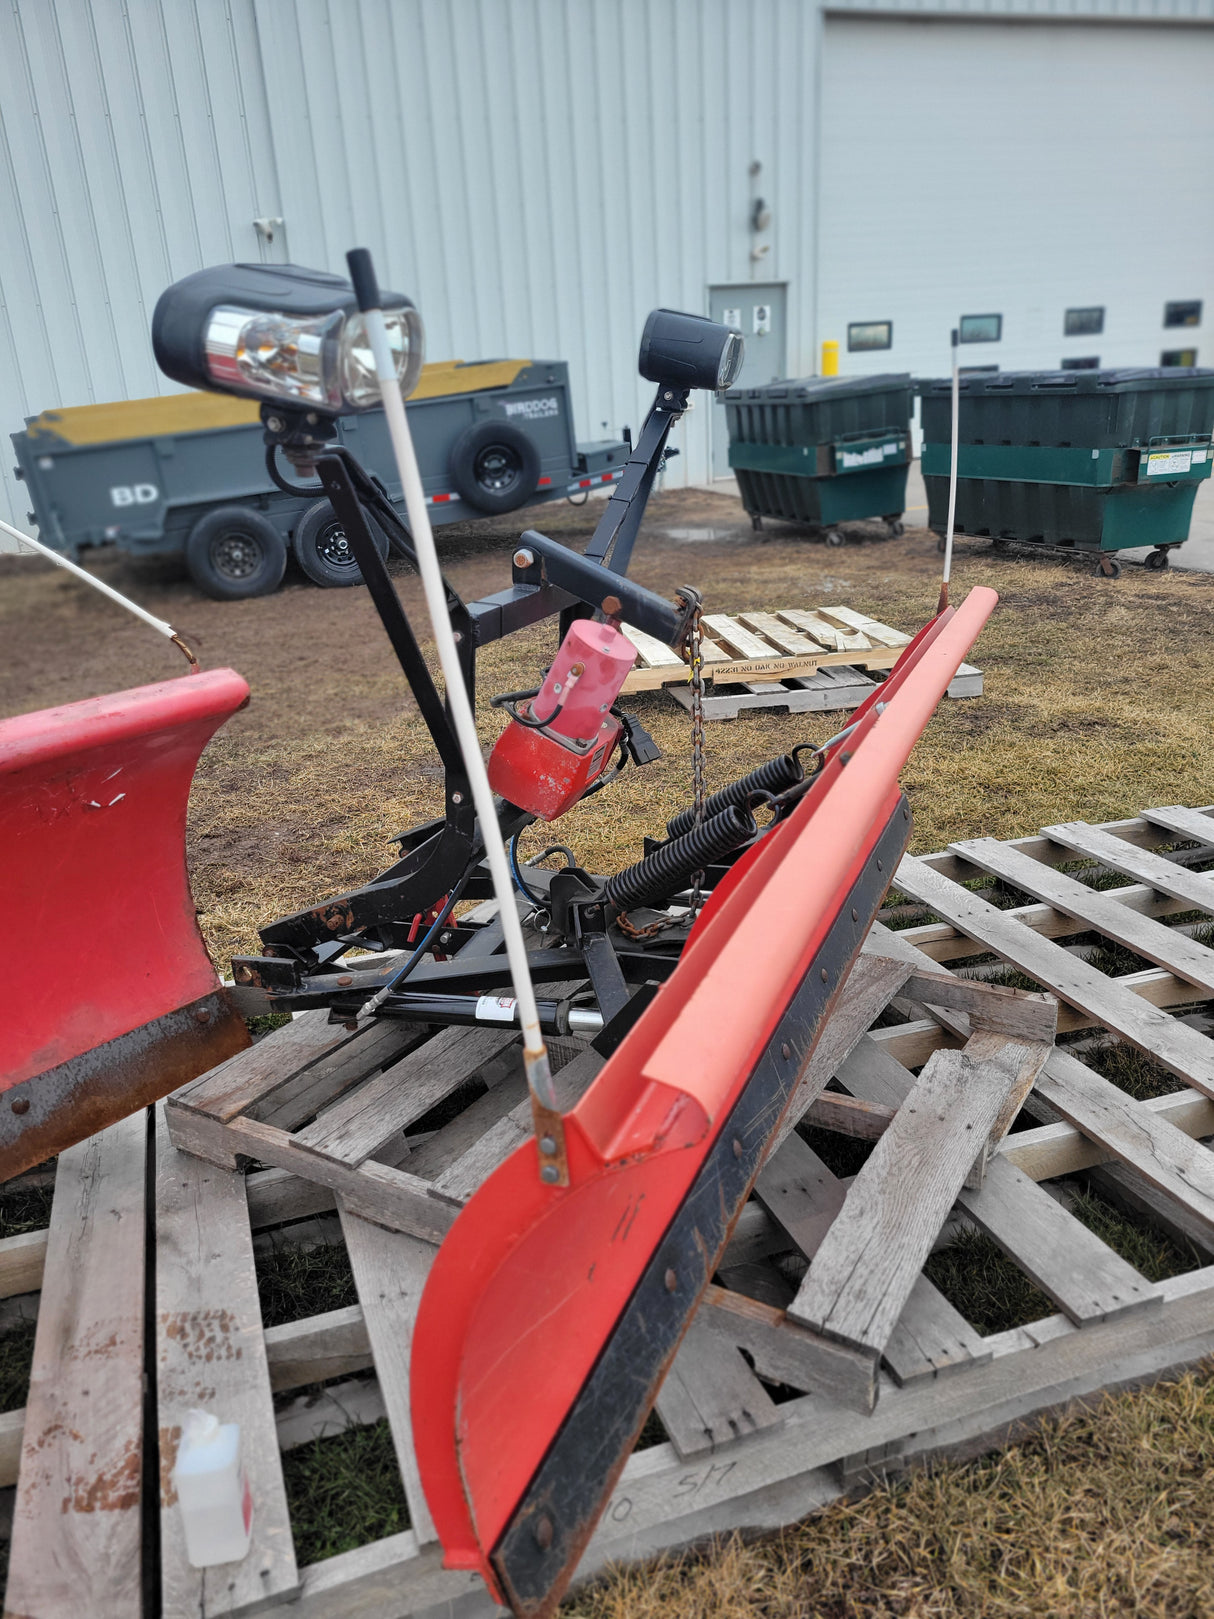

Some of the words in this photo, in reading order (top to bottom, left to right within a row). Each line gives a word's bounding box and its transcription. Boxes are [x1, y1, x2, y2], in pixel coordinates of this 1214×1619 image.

[111, 484, 159, 507] BD
[755, 663, 771, 671] OAK
[788, 660, 818, 669] WALNUT
